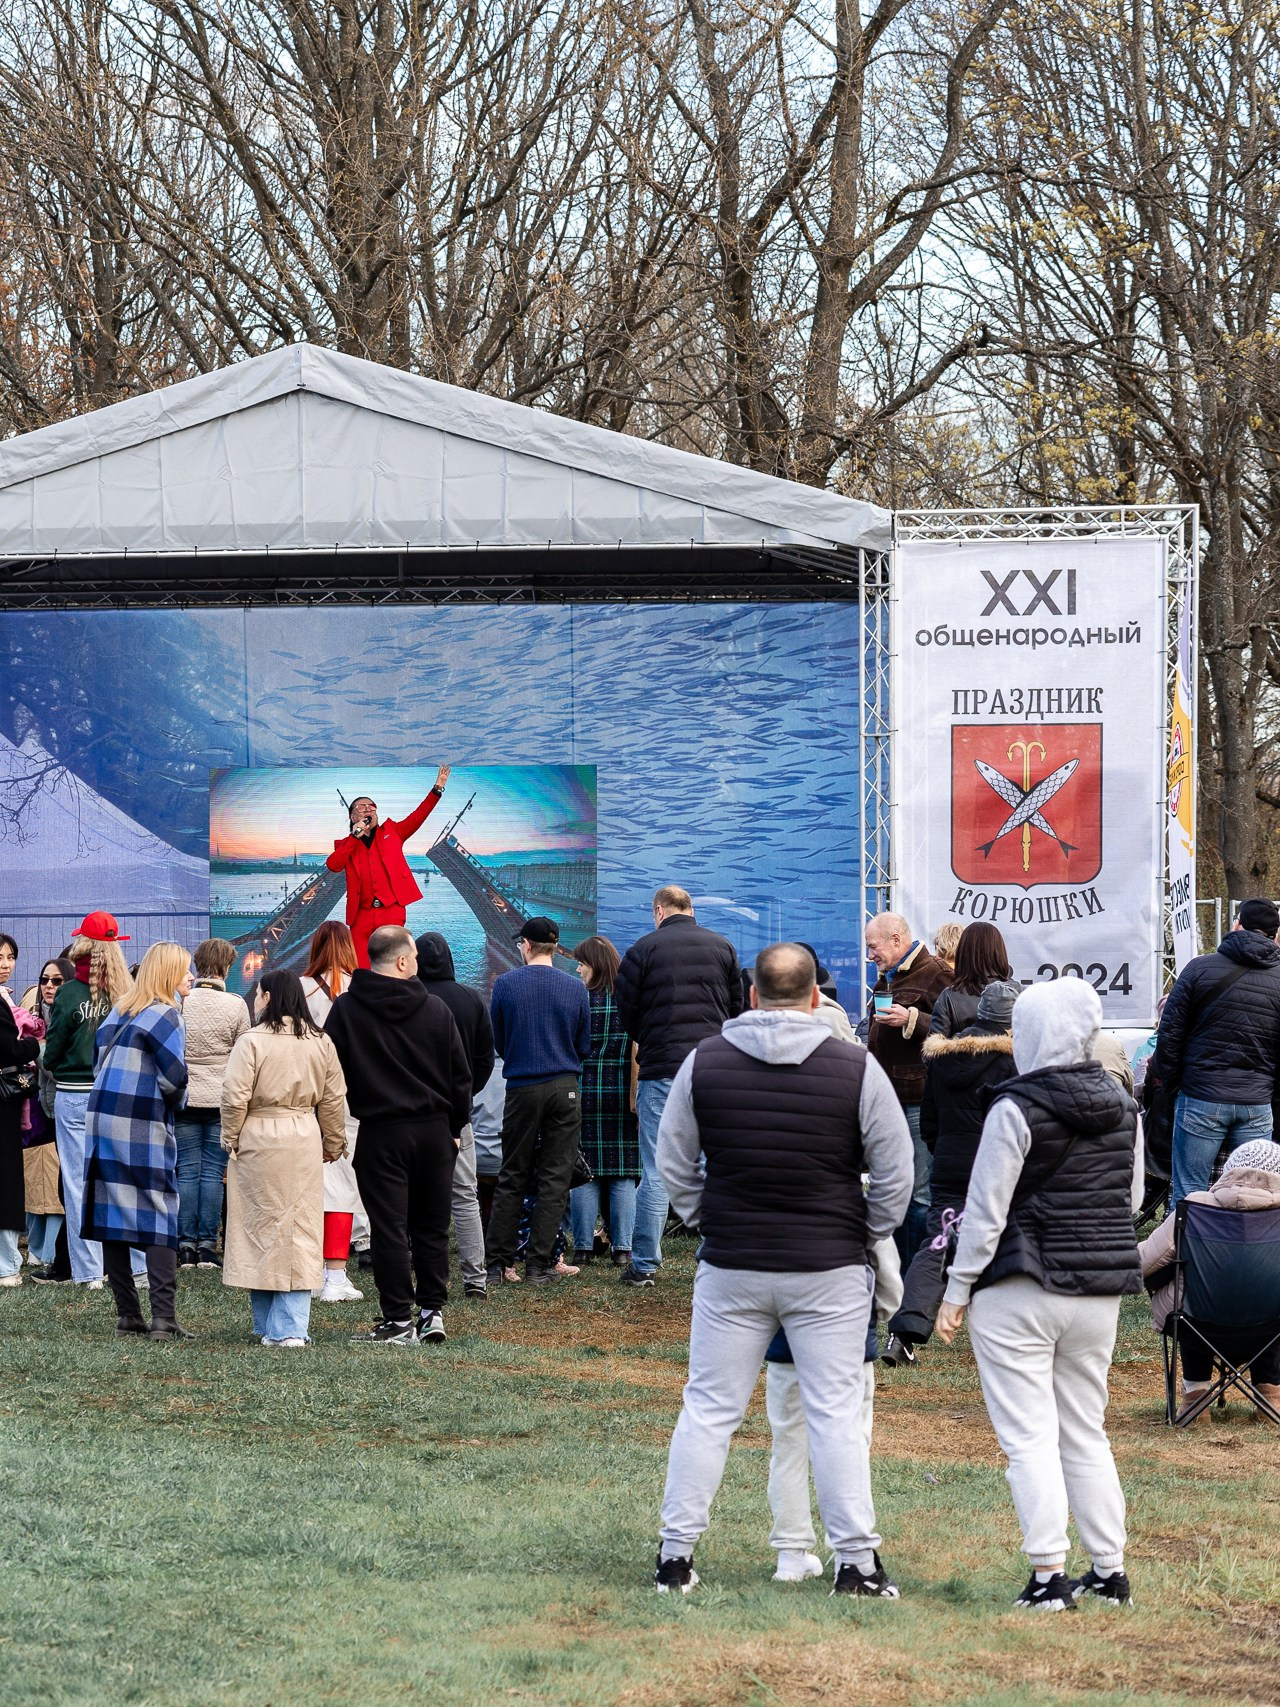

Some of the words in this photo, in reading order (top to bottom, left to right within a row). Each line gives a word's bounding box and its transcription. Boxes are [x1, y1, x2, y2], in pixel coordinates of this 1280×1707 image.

[980, 568, 1077, 616] XXI
[914, 620, 1142, 649] общенародный
[951, 687, 1105, 721] ПРАЗДНИК
[948, 886, 1107, 925] КОРЮШКИ
[1008, 962, 1133, 996] -224
